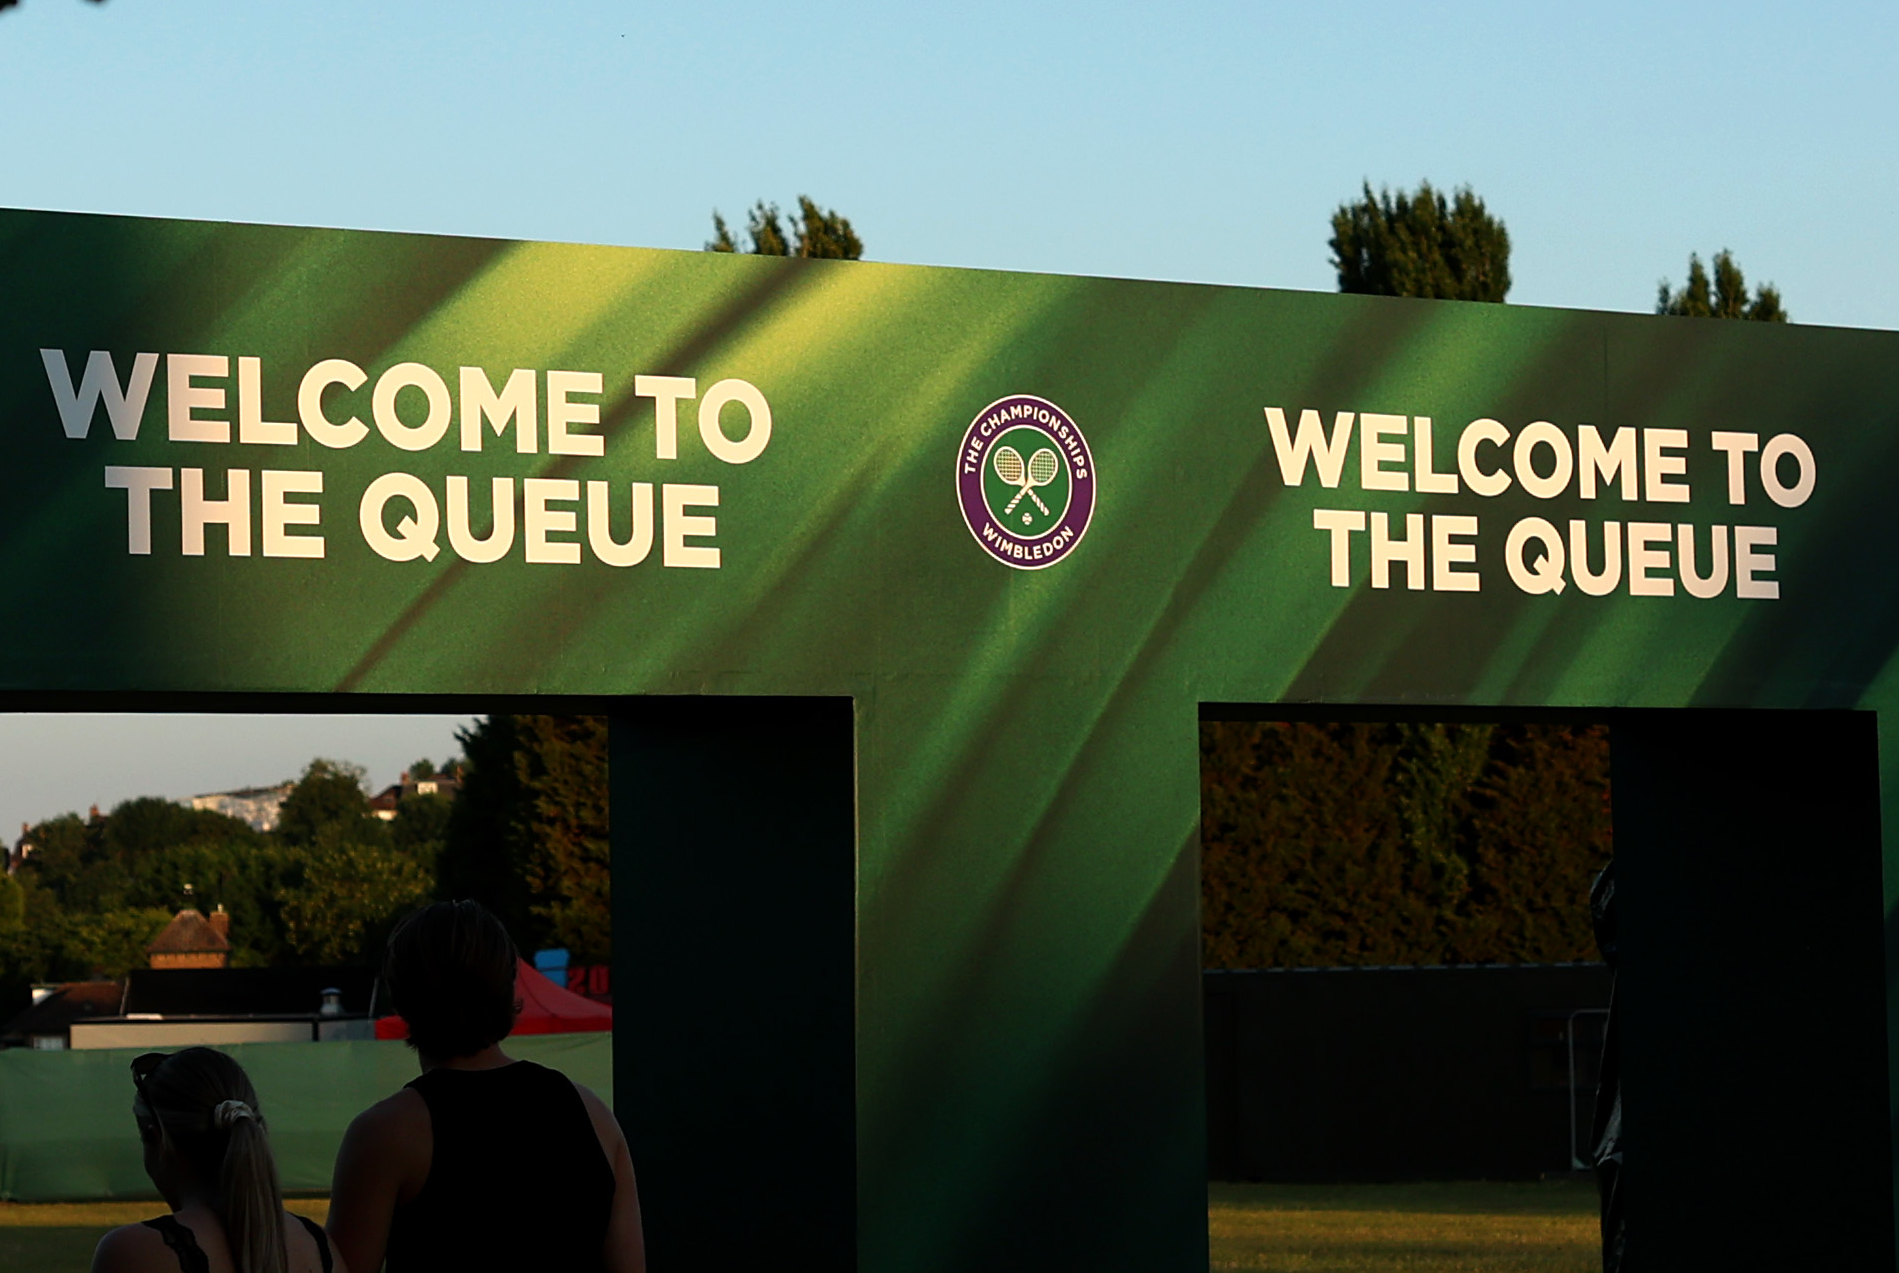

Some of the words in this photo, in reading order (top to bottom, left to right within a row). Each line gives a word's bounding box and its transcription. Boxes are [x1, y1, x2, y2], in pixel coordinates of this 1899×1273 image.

[39, 348, 605, 460] WELCOME
[634, 374, 773, 465] TO
[964, 436, 984, 475] THE
[980, 404, 1088, 480] CHAMPIONSHIPS
[1263, 406, 1691, 505] WELCOME
[1711, 430, 1817, 509] TO
[105, 465, 325, 559] THE
[359, 471, 721, 569] QUEUE
[982, 521, 1074, 560] WIMBLEDON
[1312, 508, 1481, 593] THE
[1504, 516, 1780, 600] QUEUE
